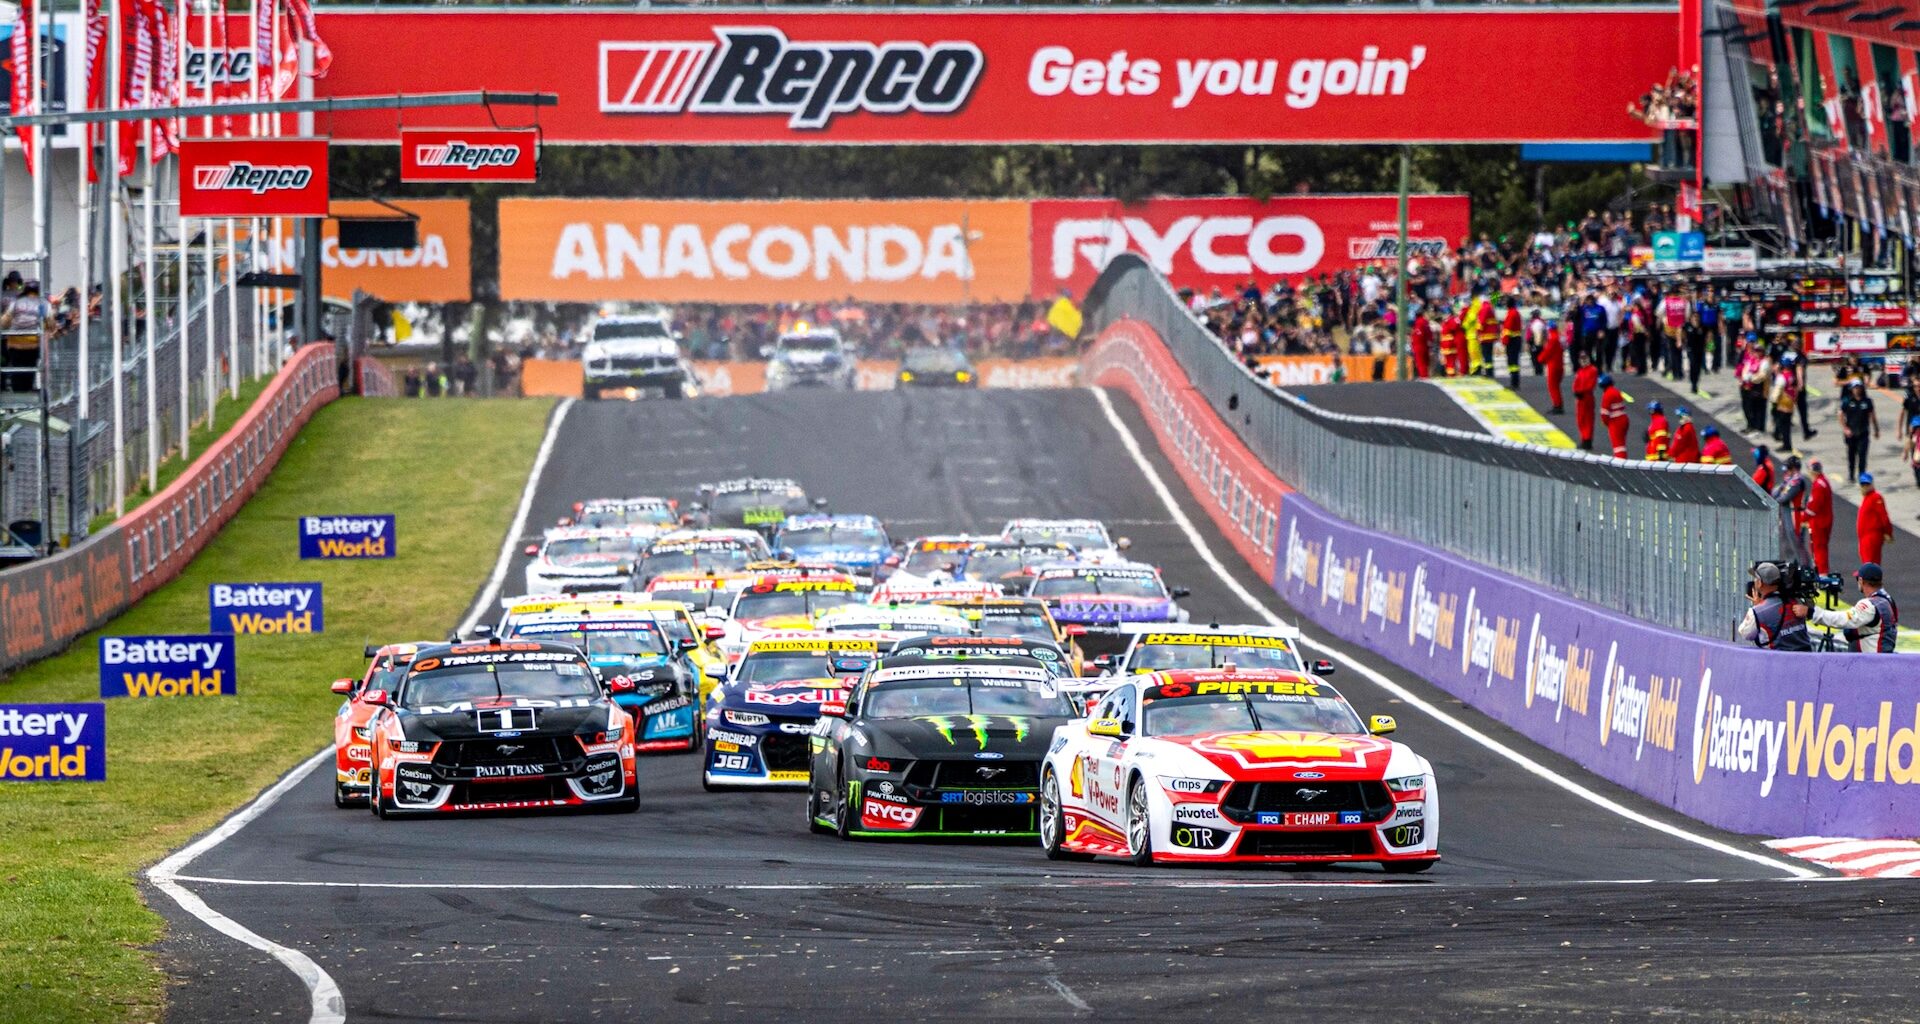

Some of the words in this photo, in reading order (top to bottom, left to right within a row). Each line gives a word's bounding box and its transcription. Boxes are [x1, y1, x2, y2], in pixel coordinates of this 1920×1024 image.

[688, 26, 985, 127] Repco
[1028, 46, 1161, 96] Gets
[1173, 58, 1275, 108] you
[446, 143, 519, 169] Repco
[224, 161, 313, 194] Repco
[552, 223, 974, 281] ANACONDA
[1052, 215, 1325, 279] RYCO
[305, 518, 385, 535] Battery
[319, 538, 385, 556] World
[213, 584, 312, 610] Battery
[230, 612, 312, 633] World
[752, 642, 825, 652] NATIONAL
[1147, 632, 1288, 650] Hydraulink
[104, 638, 222, 671] Battery
[443, 655, 507, 666] TRUCK
[508, 653, 577, 661] ASSIST
[523, 663, 552, 671] Wood
[123, 671, 222, 697] World
[981, 679, 1022, 687] Waters
[1197, 682, 1319, 695] PIRTEK
[1536, 635, 1568, 723] Battery
[1564, 644, 1593, 716] World
[745, 690, 822, 705] Red
[1265, 694, 1307, 703] Kostecki
[1612, 665, 1650, 761] Battery
[1646, 675, 1681, 752] World
[708, 728, 757, 747] SUPERCHEAP
[1709, 694, 1787, 798] Battery
[1786, 700, 1920, 785] World
[714, 755, 749, 769] JGI
[867, 756, 890, 770] dba
[1087, 755, 1099, 775] Shell
[1178, 779, 1201, 793] mps
[1409, 777, 1423, 787] mps
[1087, 778, 1119, 814] V-Power
[865, 802, 917, 822] RYCO
[1261, 816, 1278, 824] PPQ
[1294, 814, 1330, 825] CH4MP
[1344, 815, 1361, 824] PPQ
[1176, 828, 1214, 847] OTR
[1395, 826, 1420, 845] OTR
